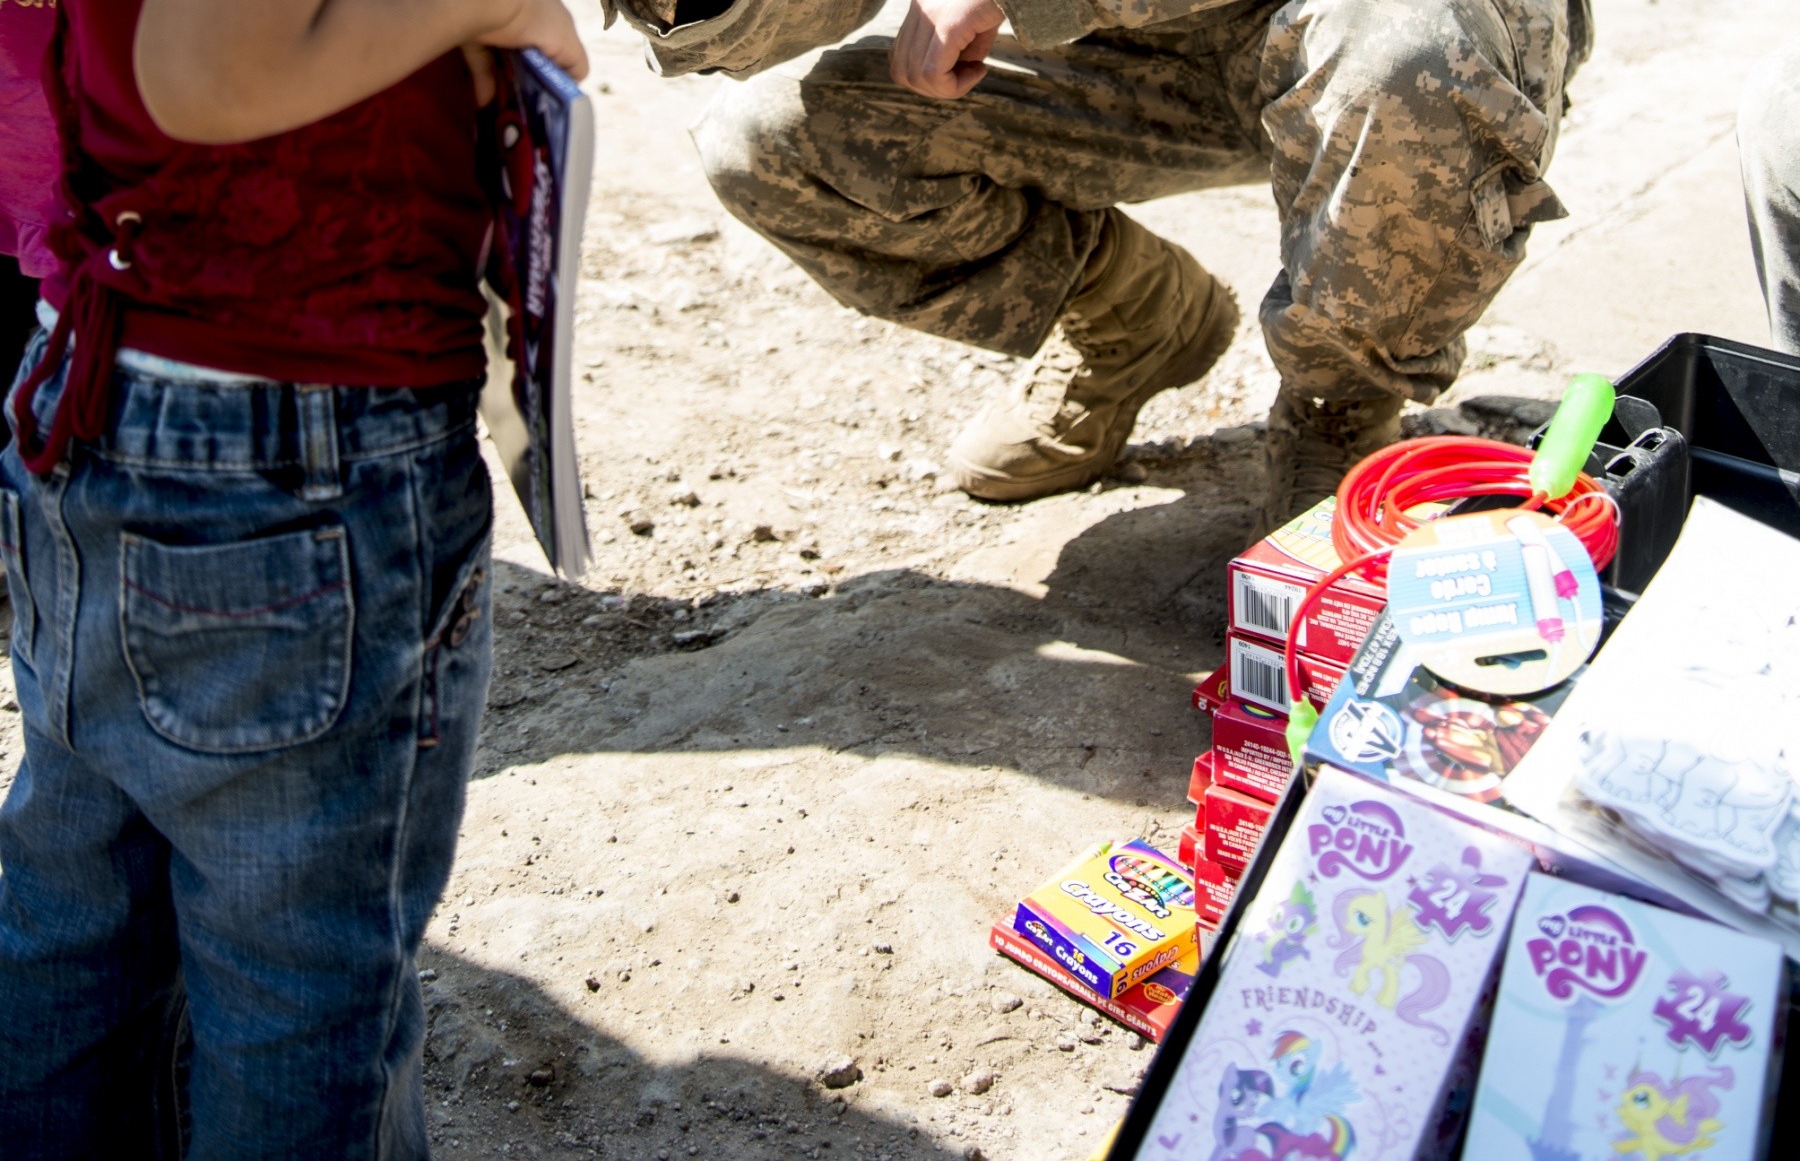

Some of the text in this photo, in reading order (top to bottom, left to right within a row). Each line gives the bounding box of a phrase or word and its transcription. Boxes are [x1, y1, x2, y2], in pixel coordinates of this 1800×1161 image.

[1431, 573, 1492, 601] Corde
[1348, 816, 1389, 837] LITTLE
[1308, 824, 1413, 881] PONY
[1059, 878, 1165, 941] Crayons
[1430, 880, 1470, 920] 24
[1073, 948, 1085, 964] 16
[1103, 930, 1137, 957] 16
[1569, 926, 1617, 946] LITTLE
[1055, 945, 1099, 985] Crayons
[1117, 945, 1179, 994] Crayons 16
[1526, 938, 1647, 999] PONY
[994, 934, 1005, 946] 10
[1004, 942, 1033, 963] JUMBO
[1097, 996, 1108, 1008] DE
[1108, 1002, 1126, 1019] CIRE
[1126, 1013, 1158, 1037] GÉANTS
[1676, 987, 1720, 1033] 24
